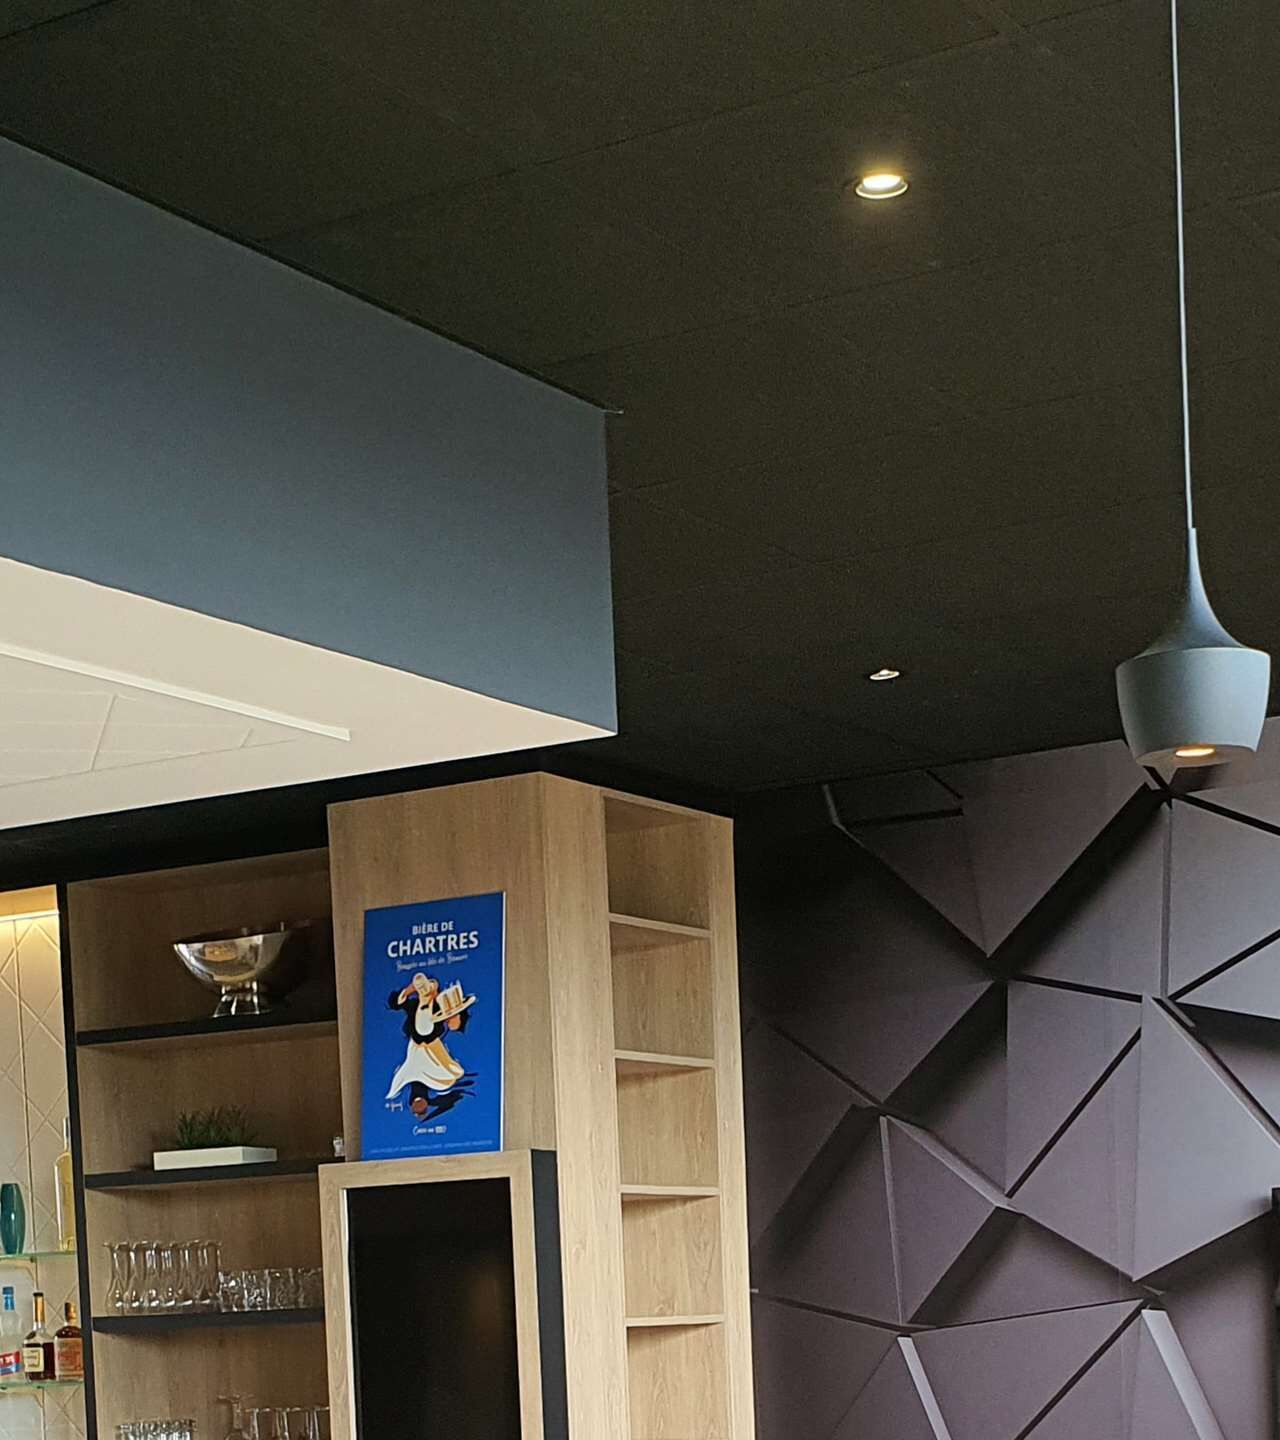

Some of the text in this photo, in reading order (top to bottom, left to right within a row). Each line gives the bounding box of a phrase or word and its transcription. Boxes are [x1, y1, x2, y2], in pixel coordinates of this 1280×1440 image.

[411, 920, 455, 936] BIÈRE DE
[387, 930, 479, 958] CHARTRES
